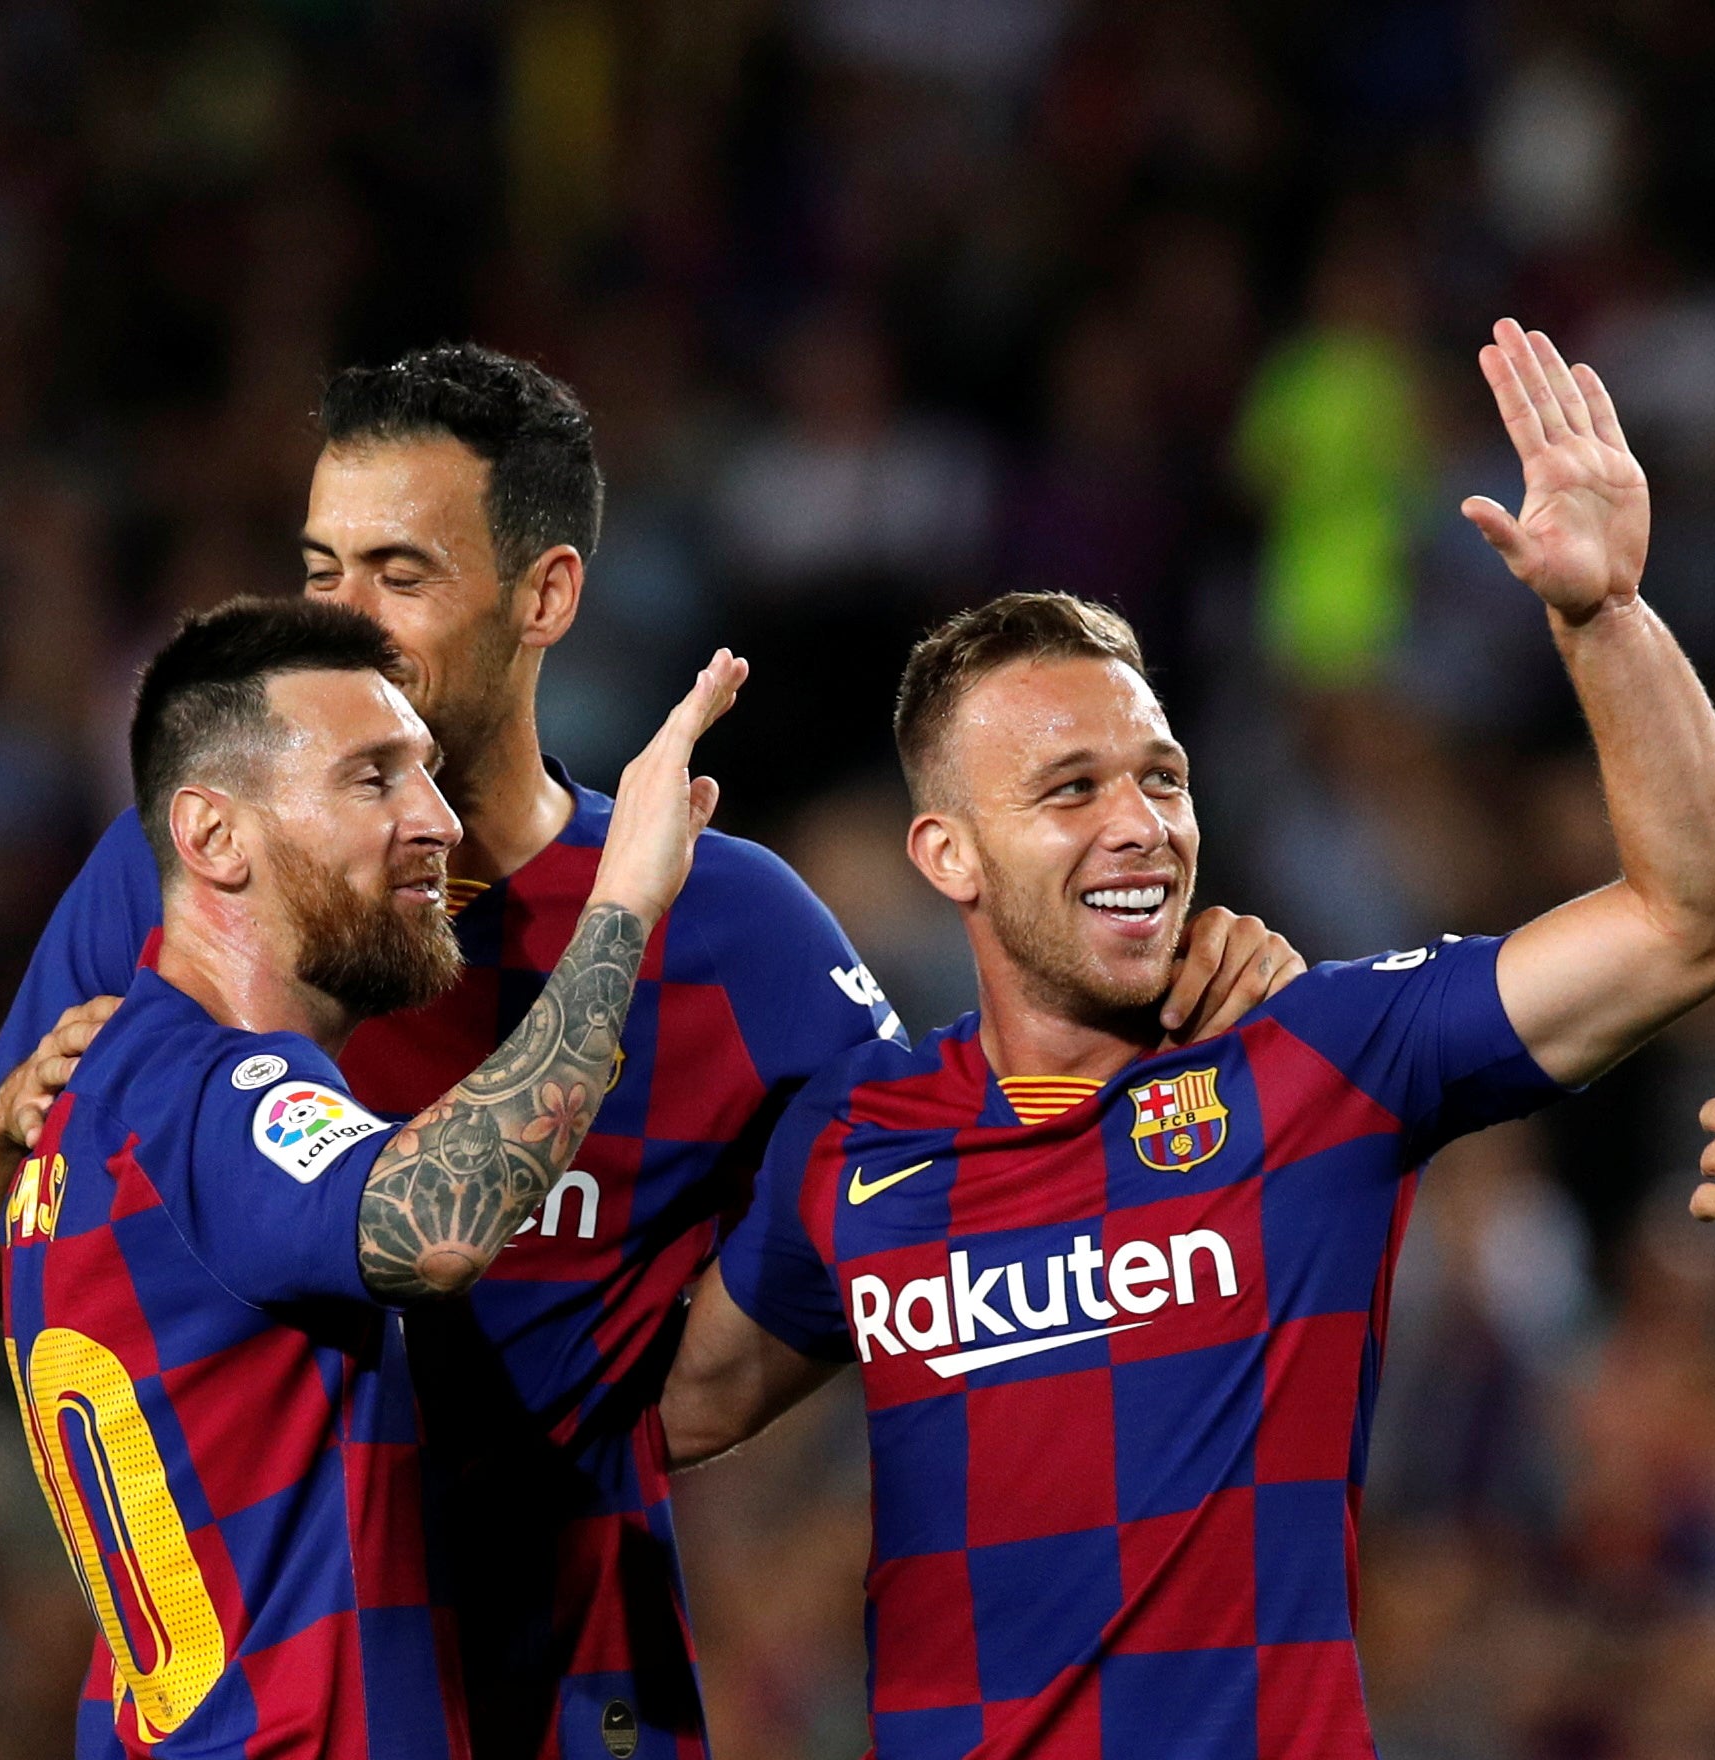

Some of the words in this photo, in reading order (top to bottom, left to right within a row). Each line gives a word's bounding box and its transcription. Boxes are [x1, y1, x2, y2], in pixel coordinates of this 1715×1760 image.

[1159, 1111, 1197, 1131] FCB
[297, 1123, 374, 1168] LaLiga
[851, 1228, 1238, 1363] Rakuten
